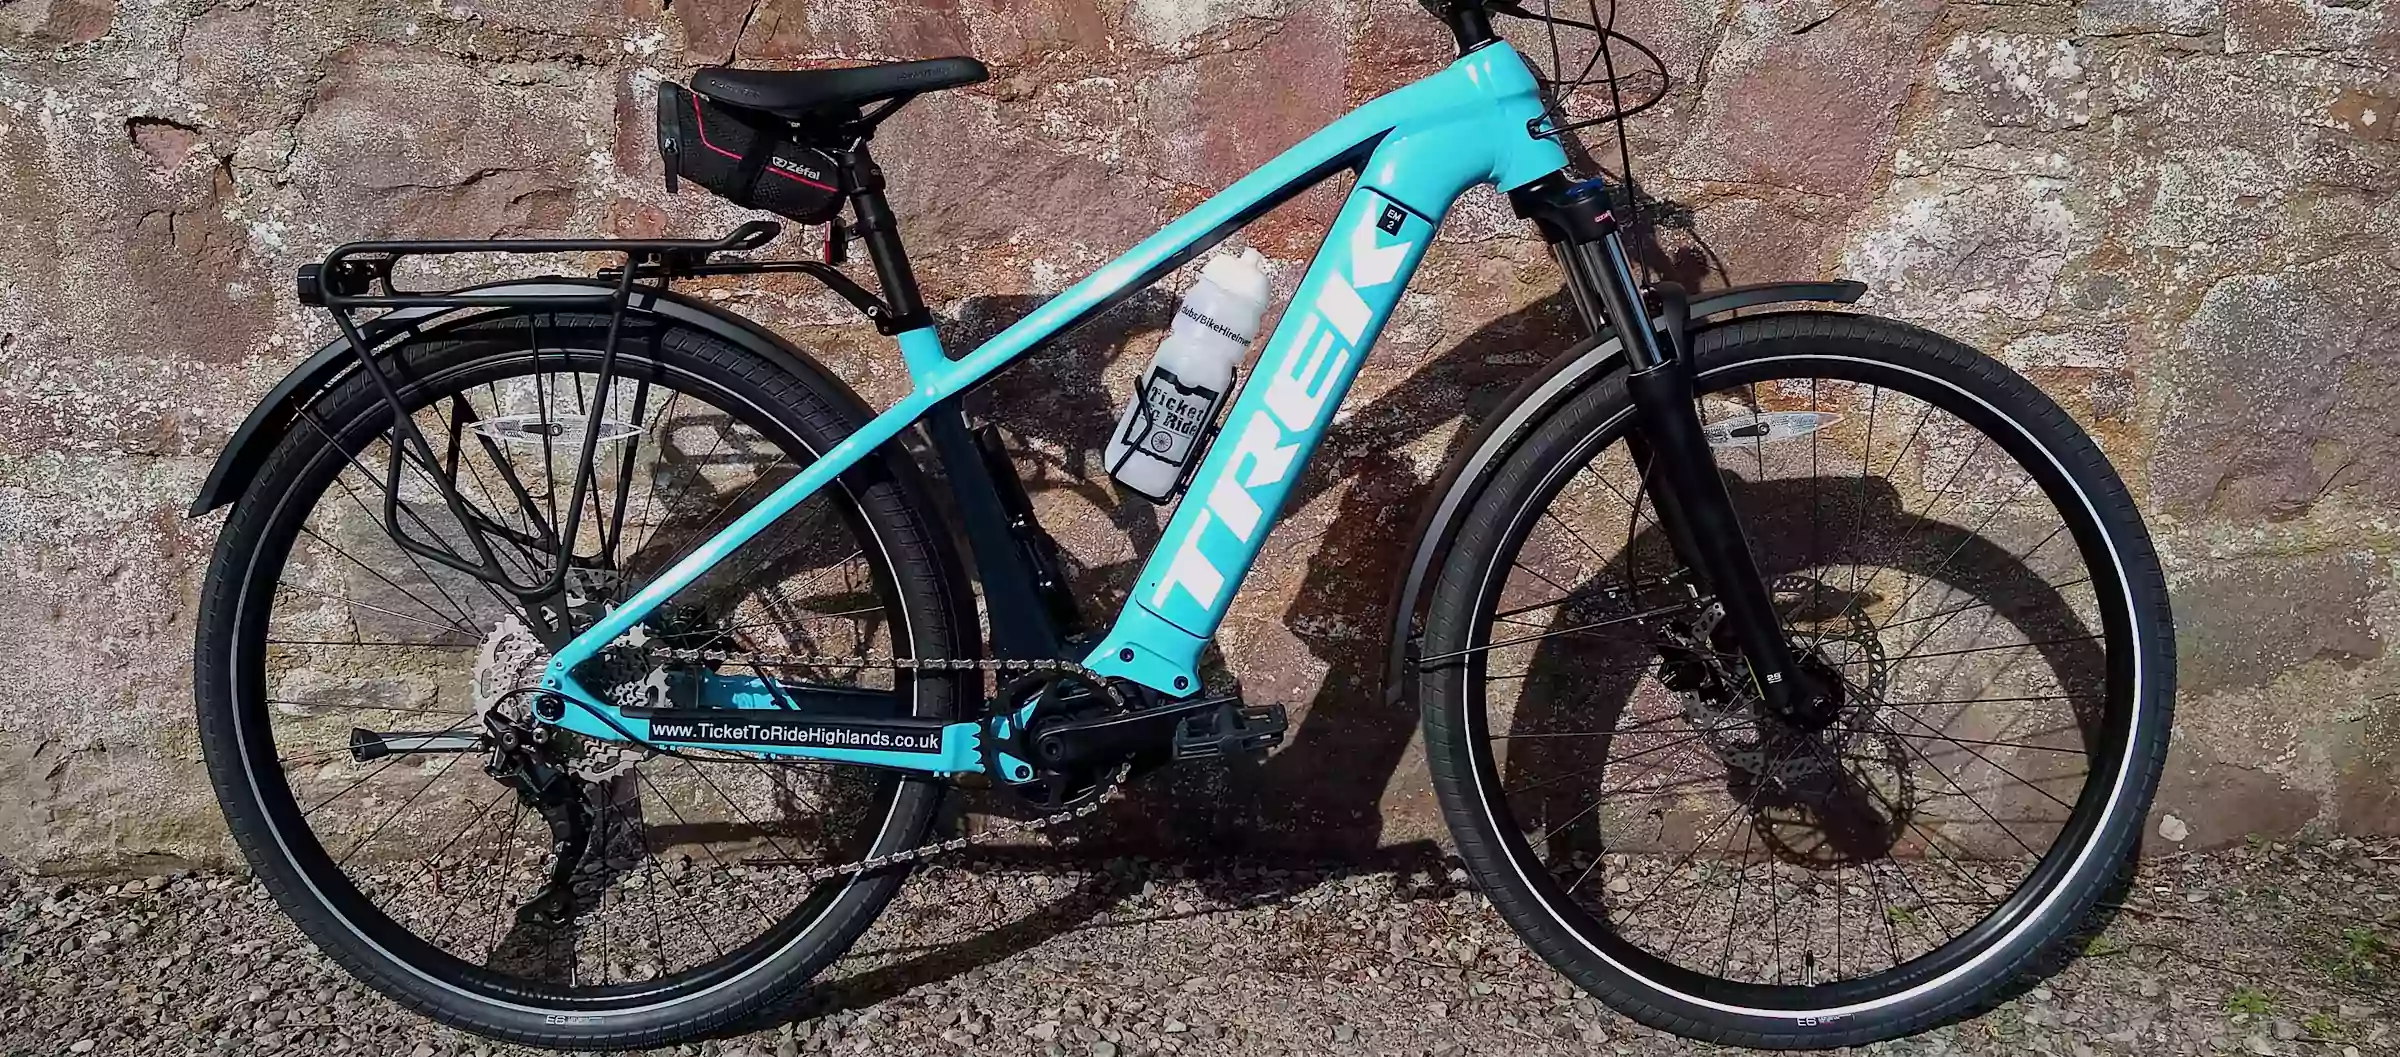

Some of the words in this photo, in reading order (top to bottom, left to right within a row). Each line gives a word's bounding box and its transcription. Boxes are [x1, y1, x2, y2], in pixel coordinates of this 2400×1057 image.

[786, 160, 821, 180] Zéfal
[1386, 208, 1402, 222] EM
[1386, 220, 1395, 229] 2
[1149, 386, 1204, 422] Ticket
[1152, 193, 1412, 611] TREK
[1163, 412, 1198, 437] Ride
[652, 723, 940, 749] www.TicketToRideHighlands.co.uk
